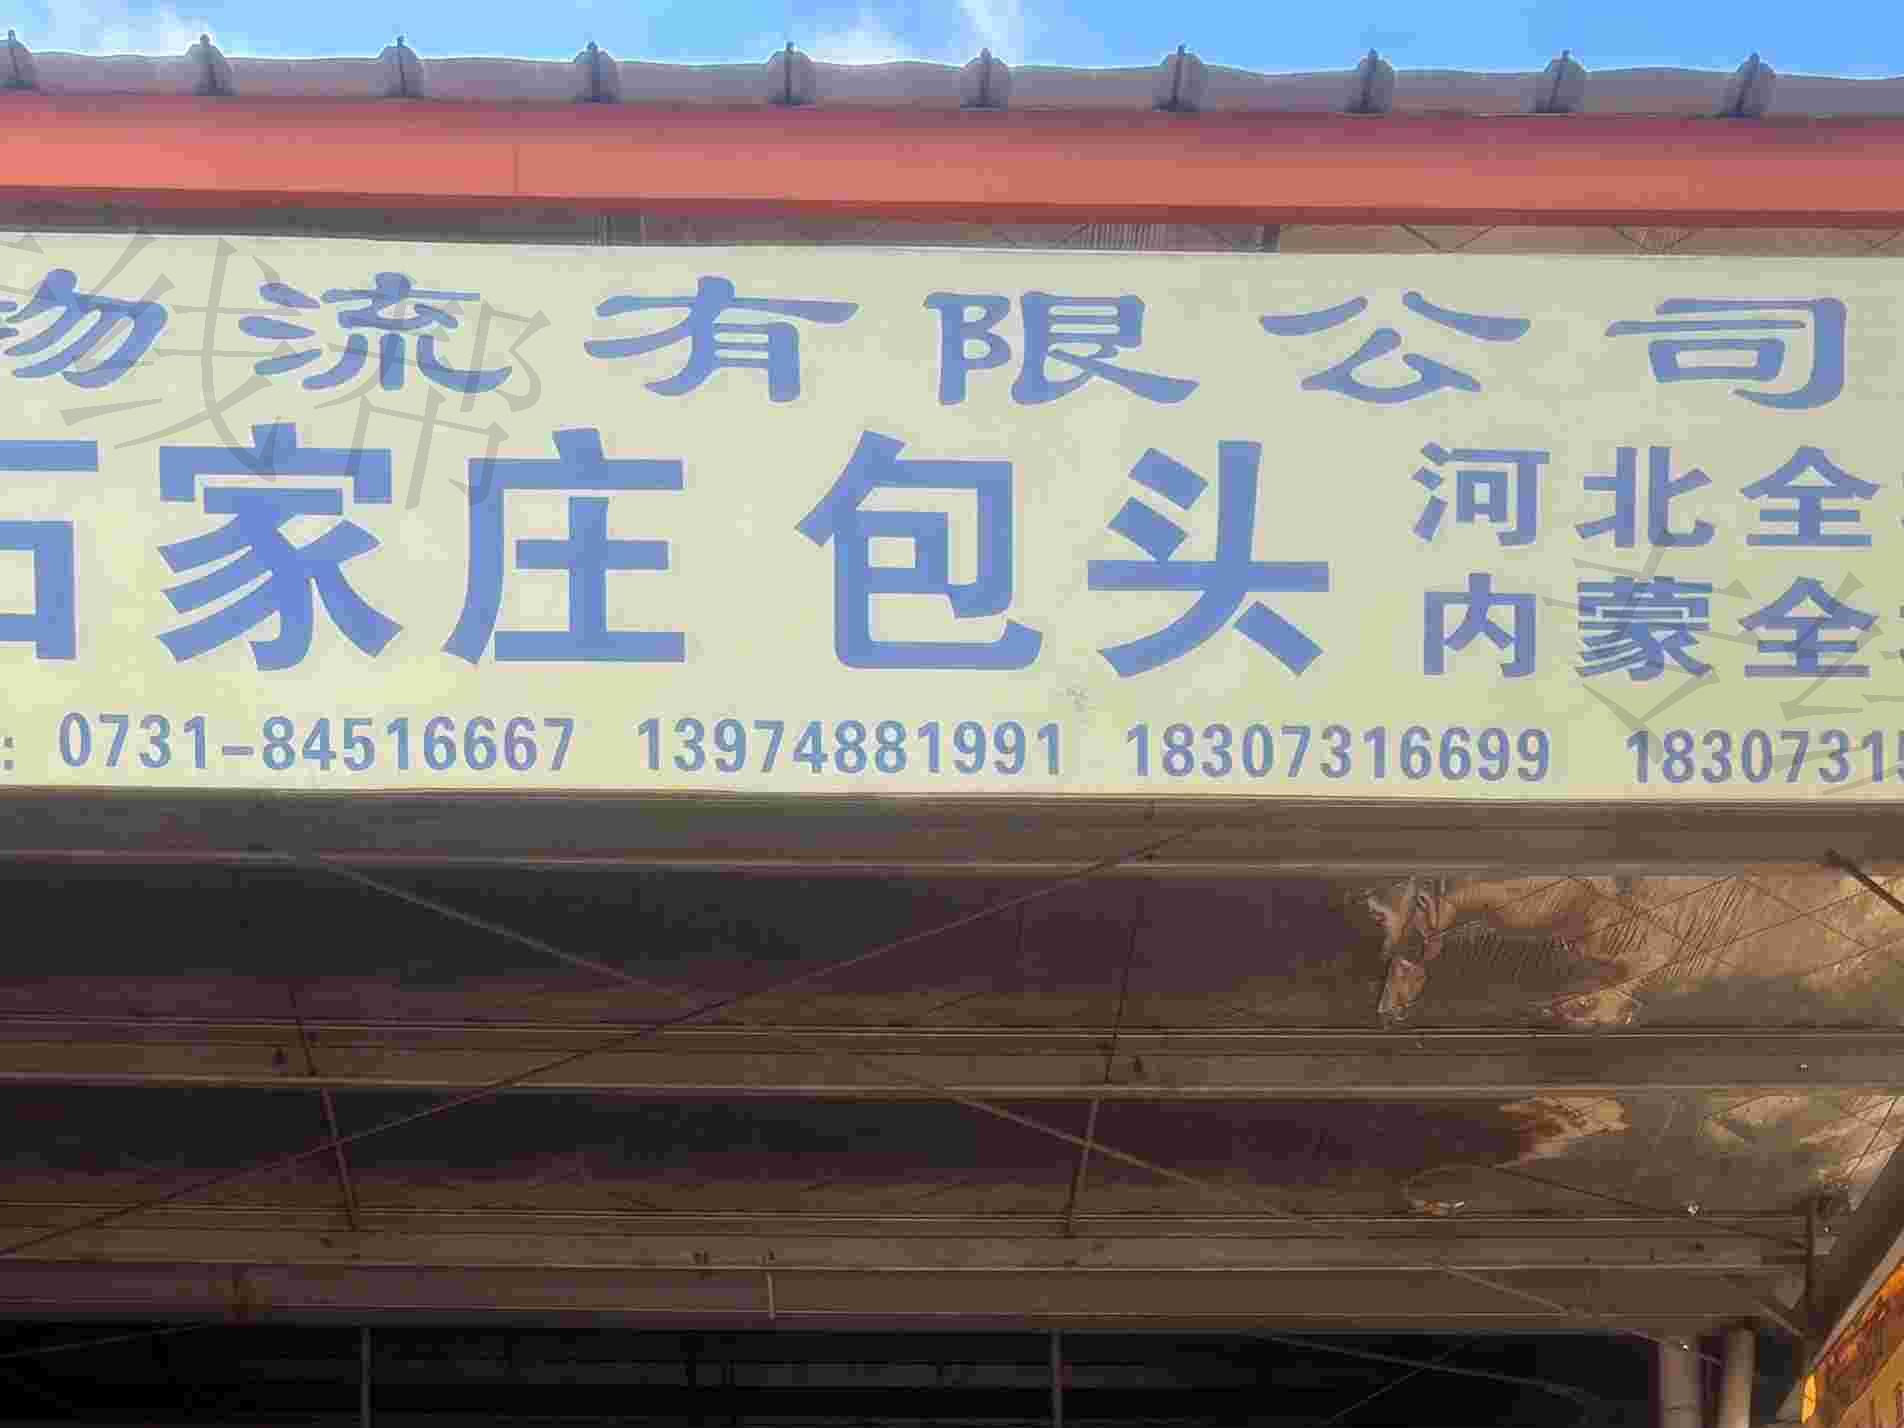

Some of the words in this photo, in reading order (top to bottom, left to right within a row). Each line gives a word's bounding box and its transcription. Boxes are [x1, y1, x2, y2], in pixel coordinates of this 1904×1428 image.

[795, 430, 1331, 678] 包头
[636, 718, 1063, 779] 13974881991
[1125, 722, 1551, 783] 18307316699
